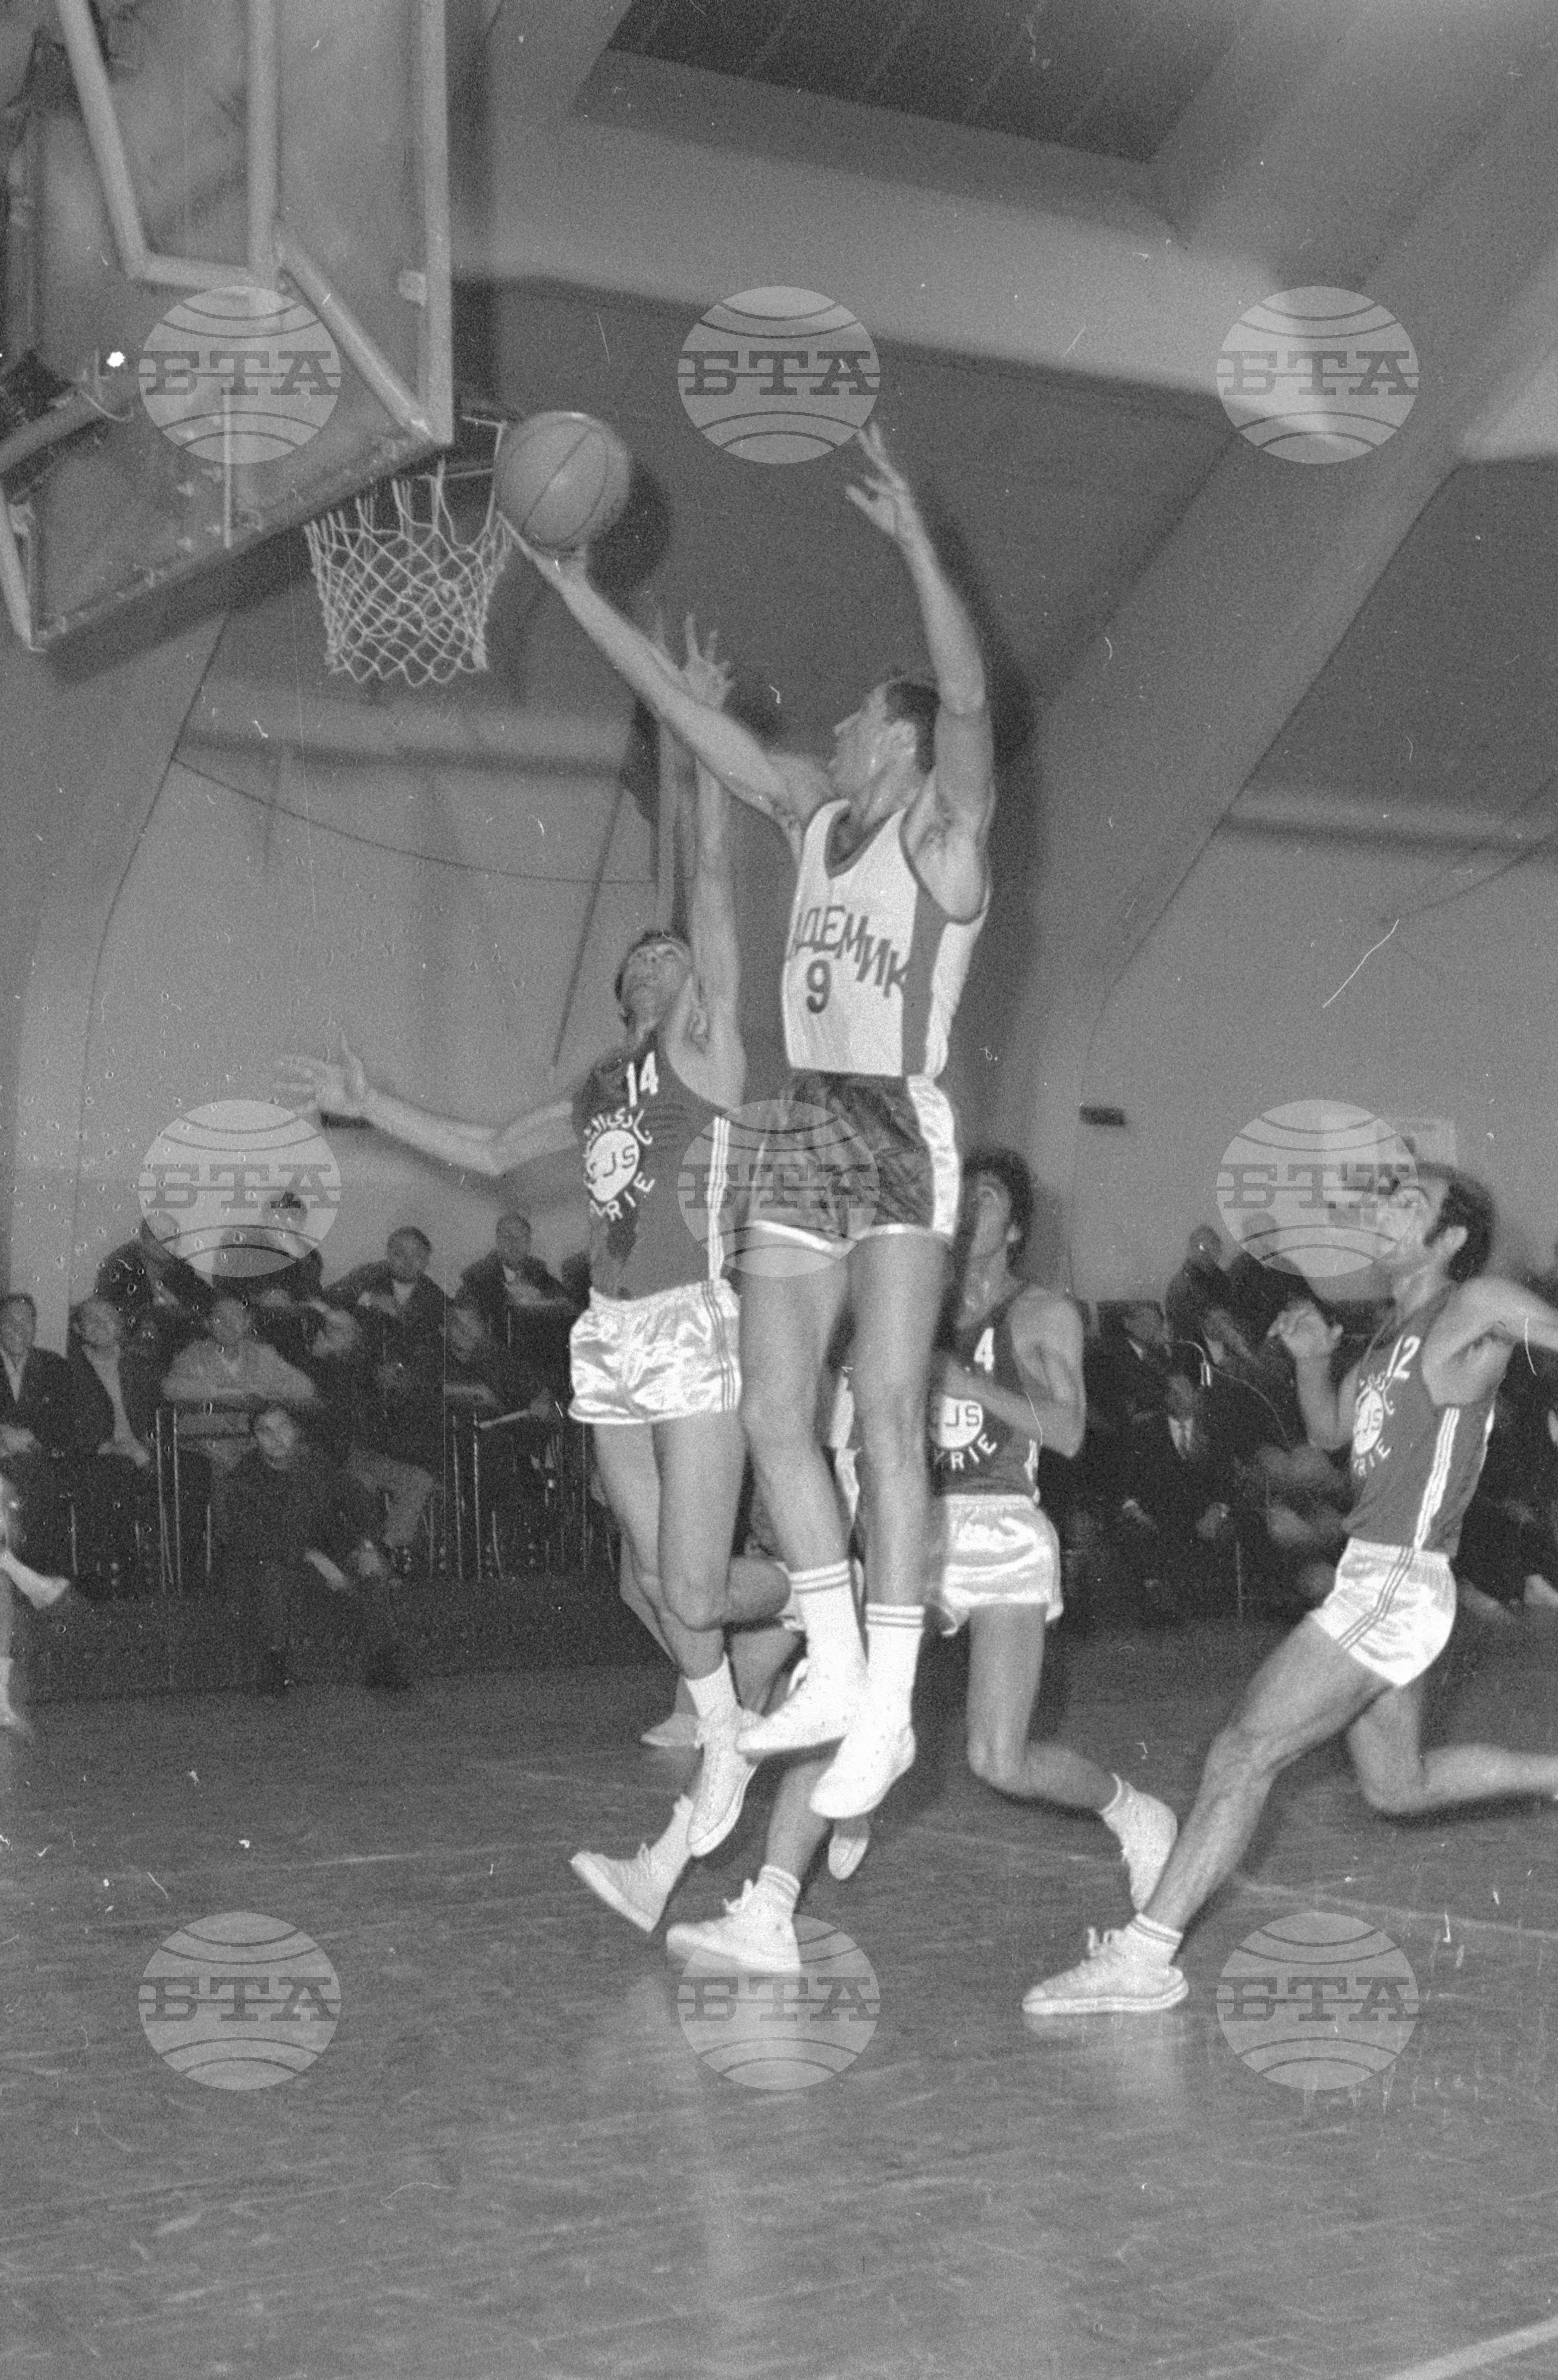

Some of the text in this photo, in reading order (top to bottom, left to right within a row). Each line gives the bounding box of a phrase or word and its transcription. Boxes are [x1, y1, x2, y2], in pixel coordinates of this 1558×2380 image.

[806, 959, 832, 1013] 9
[626, 1051, 658, 1107] 14
[974, 1327, 994, 1373] 4
[1386, 1335, 1421, 1380] 12
